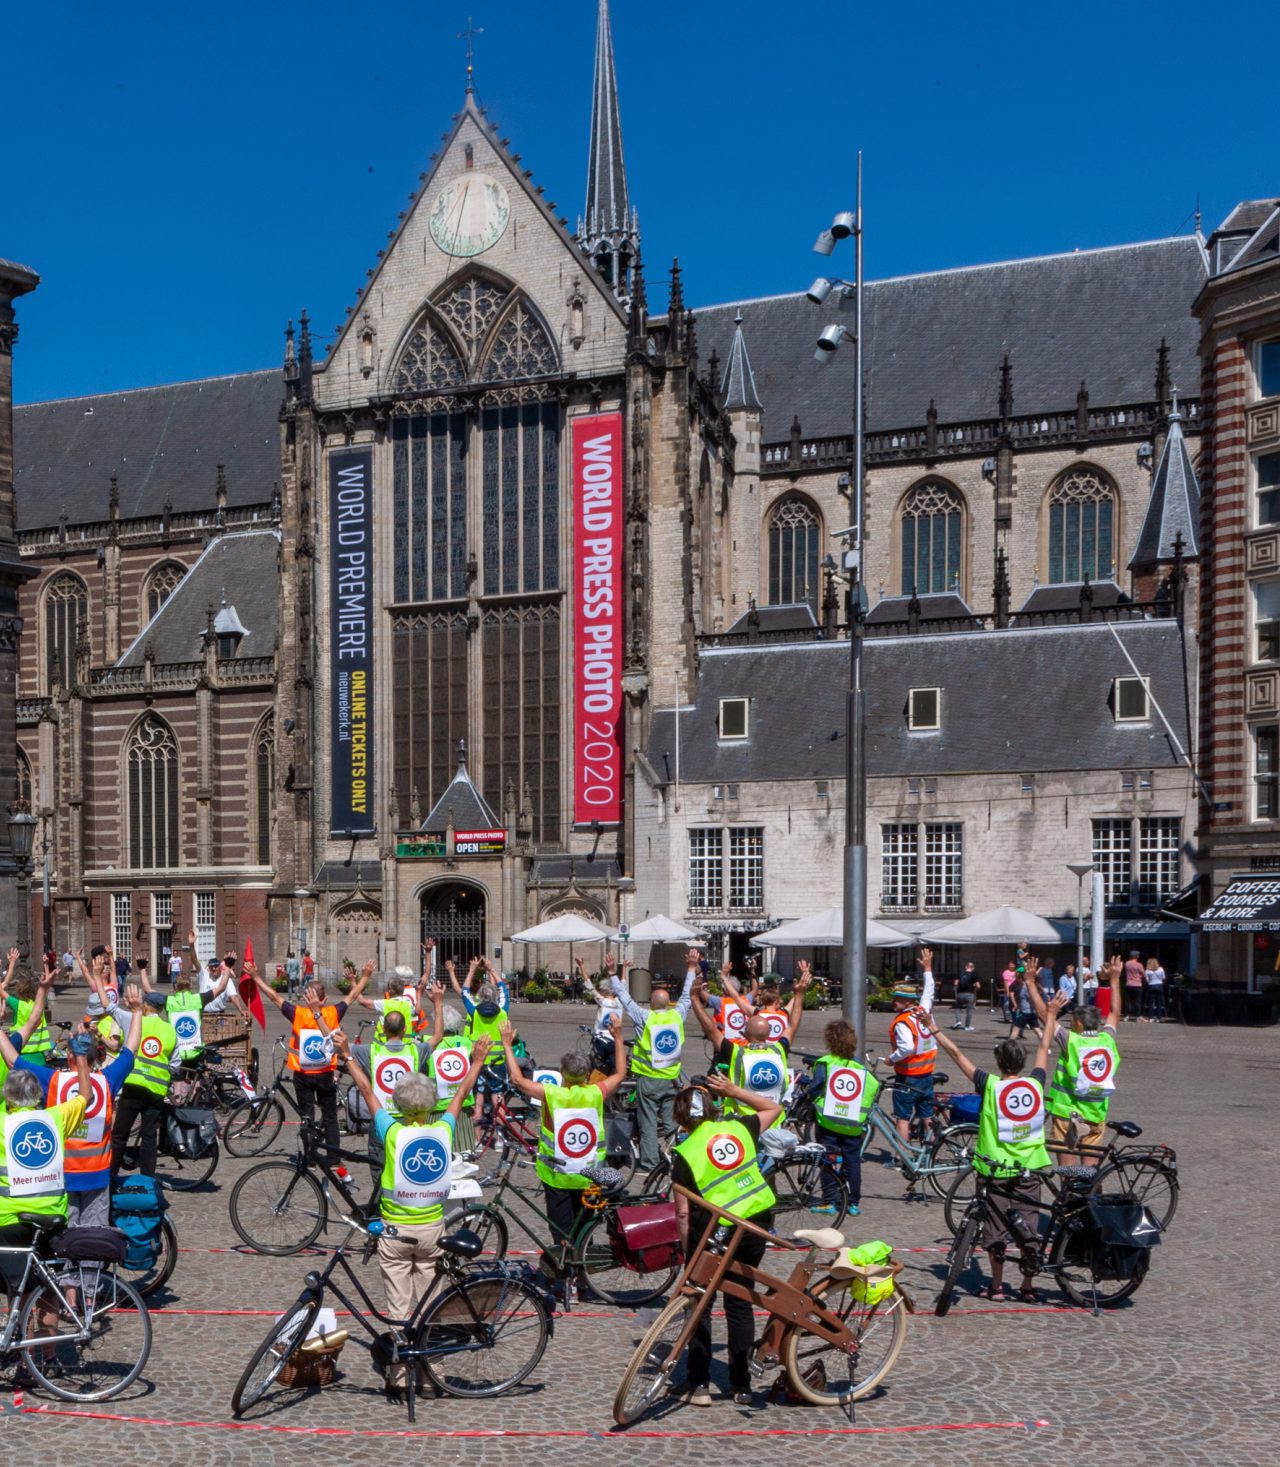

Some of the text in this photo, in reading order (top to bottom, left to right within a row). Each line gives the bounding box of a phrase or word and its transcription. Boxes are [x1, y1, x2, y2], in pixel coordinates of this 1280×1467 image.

[338, 464, 366, 659] WORLD PREMIERE
[583, 433, 613, 805] WORLD PRESS PHOTO 2020
[338, 671, 351, 741] nieuwekerk.nl
[351, 670, 367, 813] ONLINE TICKETS ONLY
[456, 843, 479, 853] OPEN
[1213, 894, 1280, 906] COOKIES
[1200, 907, 1263, 919] & MORE
[731, 1016, 743, 1024] 30
[145, 1042, 158, 1052] 30
[443, 1060, 461, 1071] 30
[1090, 1060, 1105, 1071] 30
[836, 1079, 855, 1091] 30
[1009, 1094, 1033, 1109] 30
[567, 1131, 589, 1145] 30
[714, 1142, 736, 1161] 30
[13, 1176, 32, 1185] Meer
[736, 1175, 753, 1189] NU!
[397, 1190, 417, 1199] Meer
